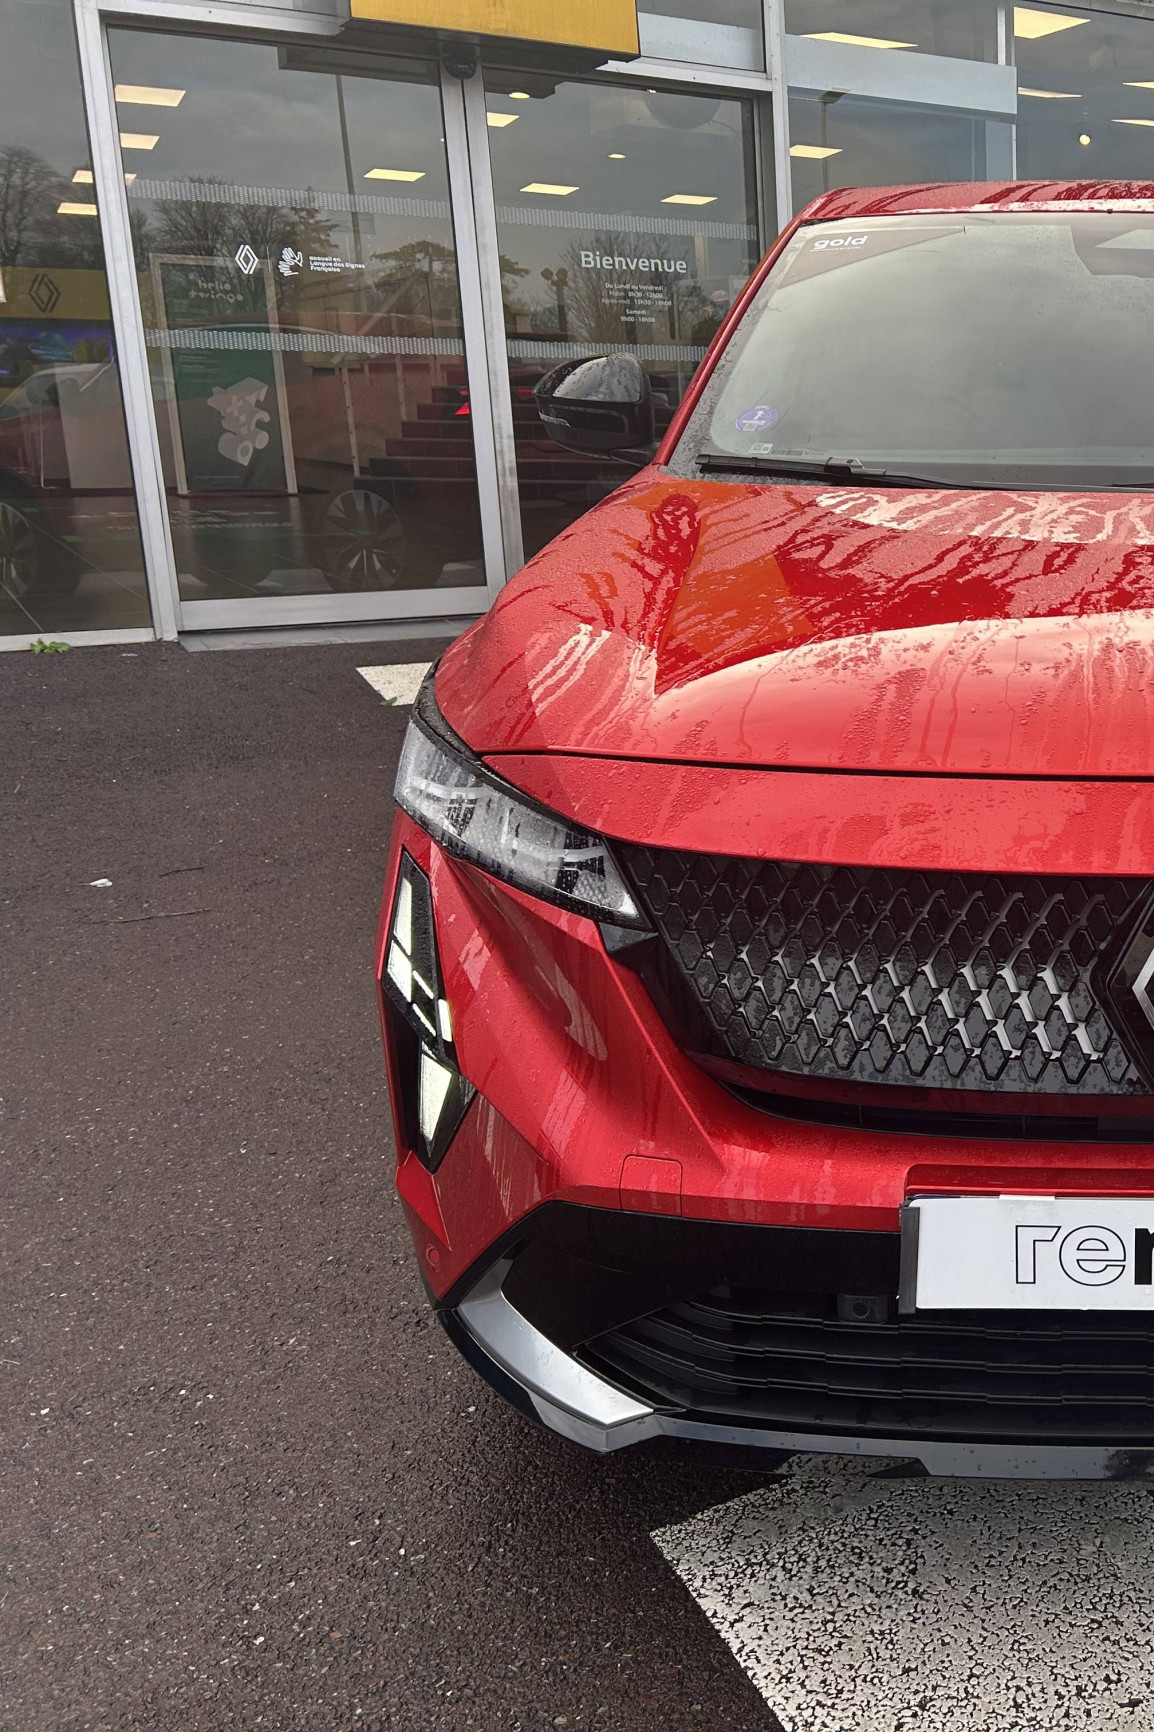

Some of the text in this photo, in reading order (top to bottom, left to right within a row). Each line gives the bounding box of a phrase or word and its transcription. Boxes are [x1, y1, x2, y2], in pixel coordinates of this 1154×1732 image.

[813, 235, 869, 250] gold
[580, 250, 687, 273] Bienvenue
[198, 279, 232, 291] hello
